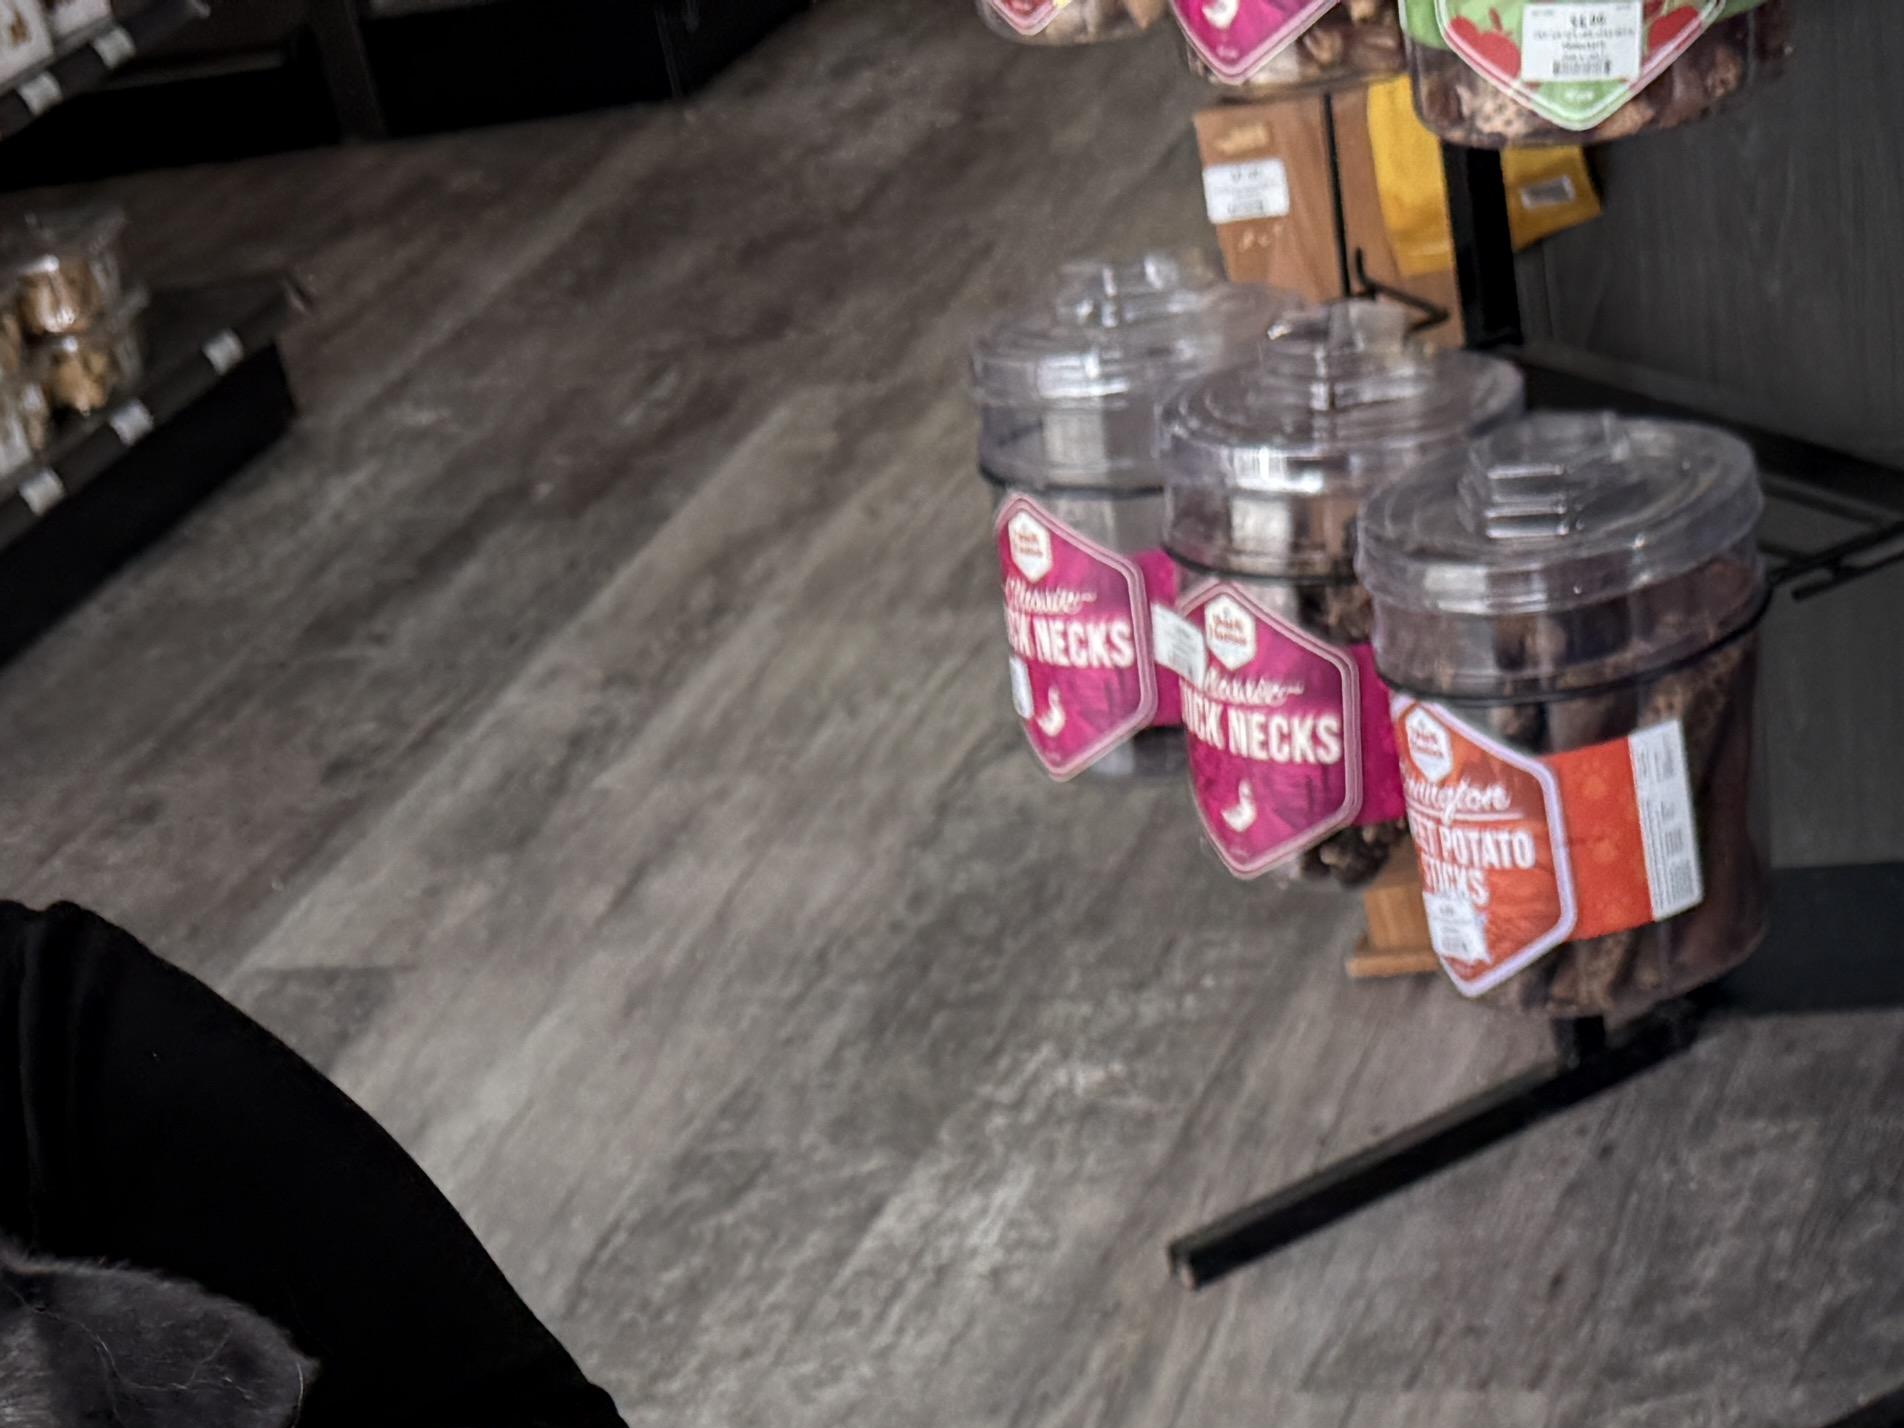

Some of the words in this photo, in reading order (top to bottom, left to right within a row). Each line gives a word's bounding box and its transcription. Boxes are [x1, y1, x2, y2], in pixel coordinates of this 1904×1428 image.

[1033, 617, 1136, 669] NECKS
[1181, 683, 1225, 750] UCK
[1226, 706, 1344, 765] NECKS
[1438, 823, 1537, 870] POTATO
